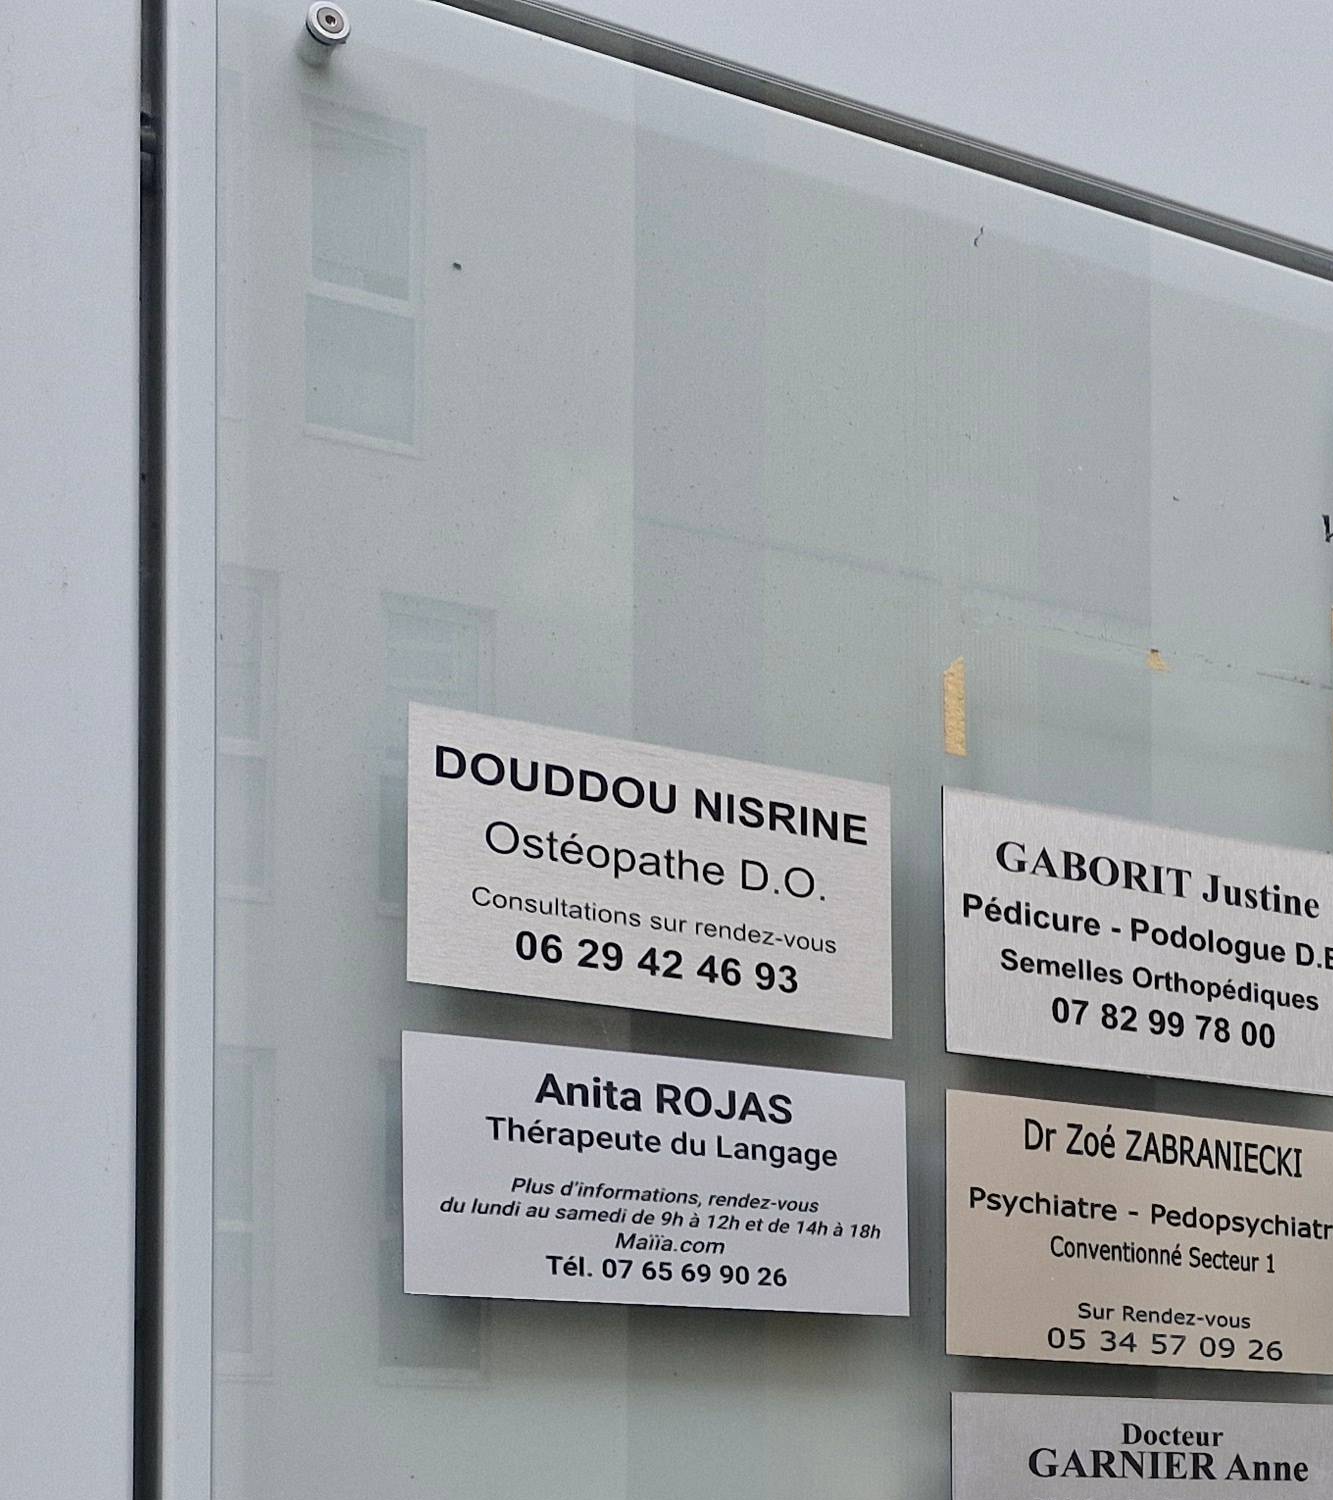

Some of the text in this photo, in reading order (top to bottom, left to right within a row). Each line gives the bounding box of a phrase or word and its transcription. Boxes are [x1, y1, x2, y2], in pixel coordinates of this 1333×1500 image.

[436, 745, 867, 845] DOUDDOU NISRINE
[486, 821, 825, 901] Ostéopathe D.O.
[996, 841, 1319, 918] GABORIT Justine
[472, 887, 836, 953] Consultations sur rendez-vous
[964, 893, 1100, 936] Pédicure
[1131, 918, 1285, 964] Podologue
[516, 931, 797, 993] 06 29 42 46 93
[1001, 949, 1319, 1011] Semelles Orthopédiques
[1052, 997, 1275, 1048] 07 82 99 78 00
[535, 1073, 792, 1124] Anita ROJAS
[486, 1116, 837, 1171] Thérapeute du Langage
[1025, 1118, 1302, 1178] Dr Zoé ZABRANIECKI
[440, 1197, 880, 1239] du lundi au samedi de 9h à 12h et de 14h à 18h
[512, 1178, 819, 1213] Plus d'informations, rendez-vous
[970, 1187, 1117, 1221] Psychiatre
[546, 1256, 787, 1286] Tél. 07 65 69 90 26
[1051, 1236, 1275, 1273] Conventionné Secteur 1
[1078, 1303, 1250, 1329] Sur Rendez-vous
[1048, 1327, 1282, 1361] 05 34 57 09 26
[1122, 1423, 1223, 1446] Docteur
[1029, 1448, 1308, 1482] GARNIER Anne
